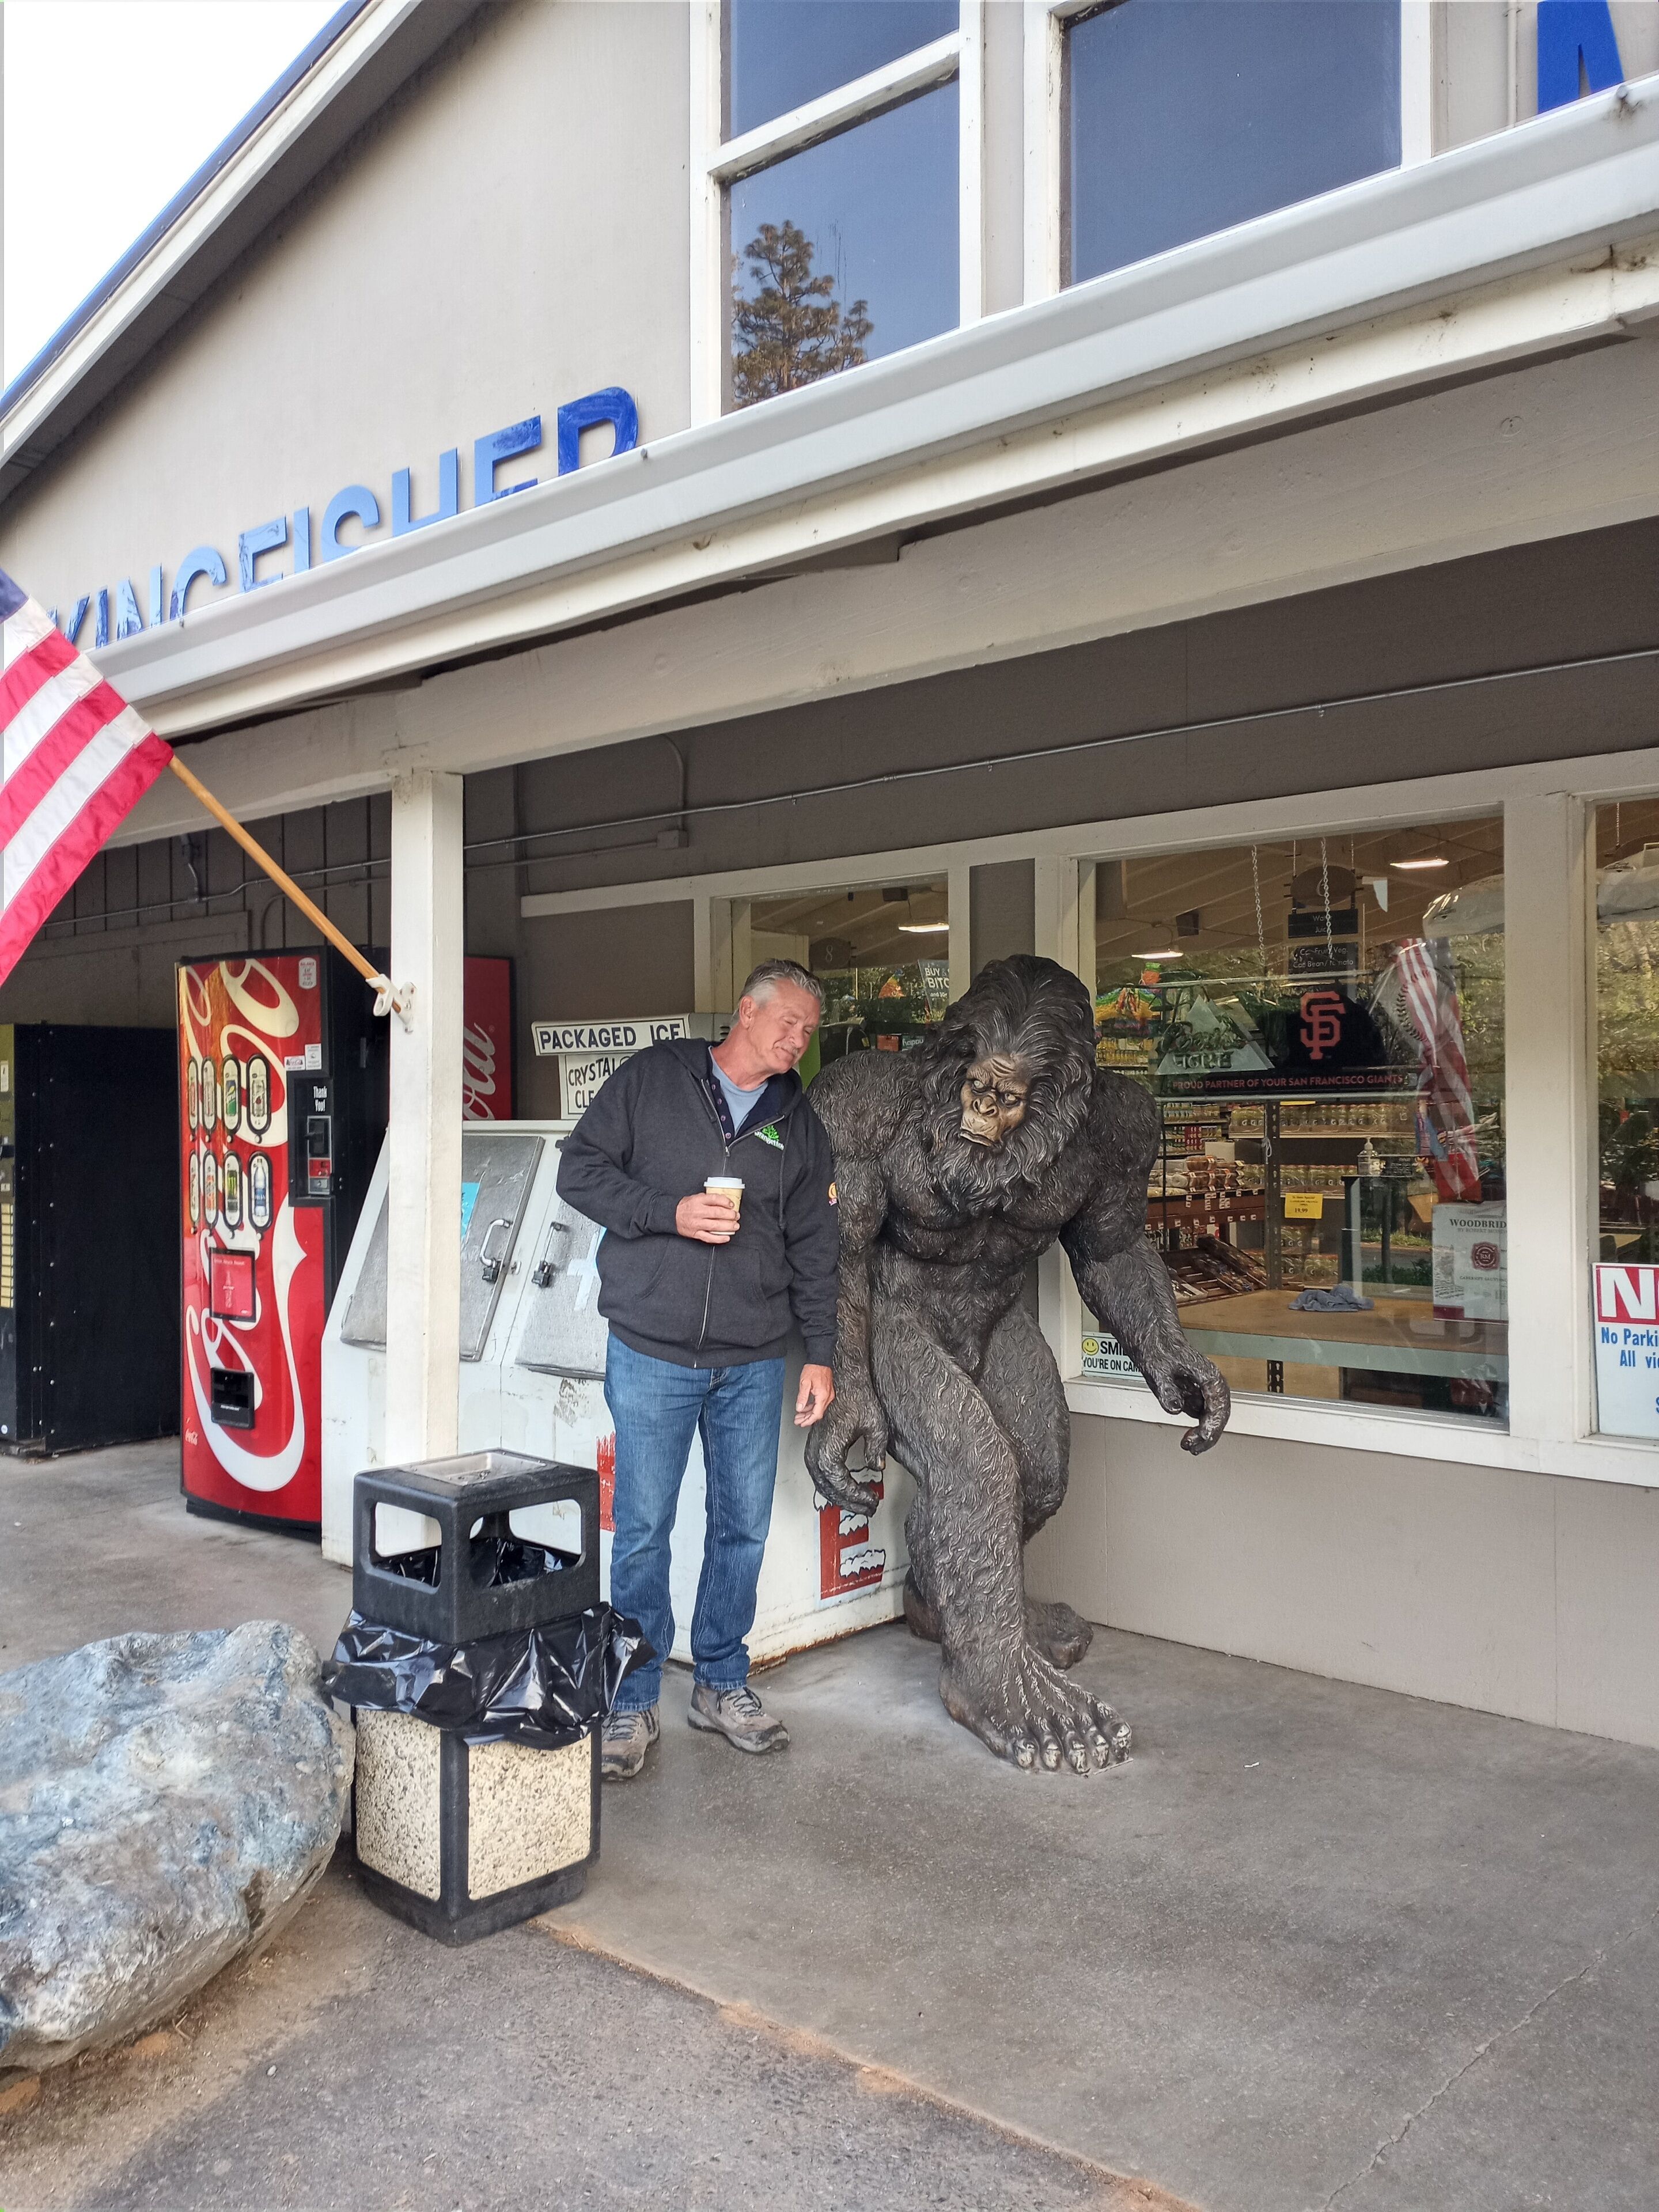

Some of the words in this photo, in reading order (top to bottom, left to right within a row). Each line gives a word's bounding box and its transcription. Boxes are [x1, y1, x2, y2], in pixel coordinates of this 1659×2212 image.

[925, 968, 940, 976] BUY
[539, 1026, 637, 1050] PACKAGED
[1173, 1081, 1203, 1090] PROUD
[1205, 1080, 1245, 1089] PARTNER
[1247, 1079, 1259, 1088] OF
[1261, 1078, 1286, 1087] YOUR
[1289, 1077, 1307, 1086] SAN
[1309, 1075, 1365, 1085] FRANCISCO
[1367, 1074, 1403, 1084] GIANTS
[313, 1086, 327, 1099] Thank
[315, 1099, 325, 1112] You!
[1449, 1218, 1507, 1228] WOODBRID
[1599, 1267, 1659, 1320] N
[1601, 1327, 1618, 1344] No
[1084, 1357, 1108, 1370] YOU'RE
[1111, 1359, 1121, 1371] ON
[1620, 1350, 1635, 1368] All
